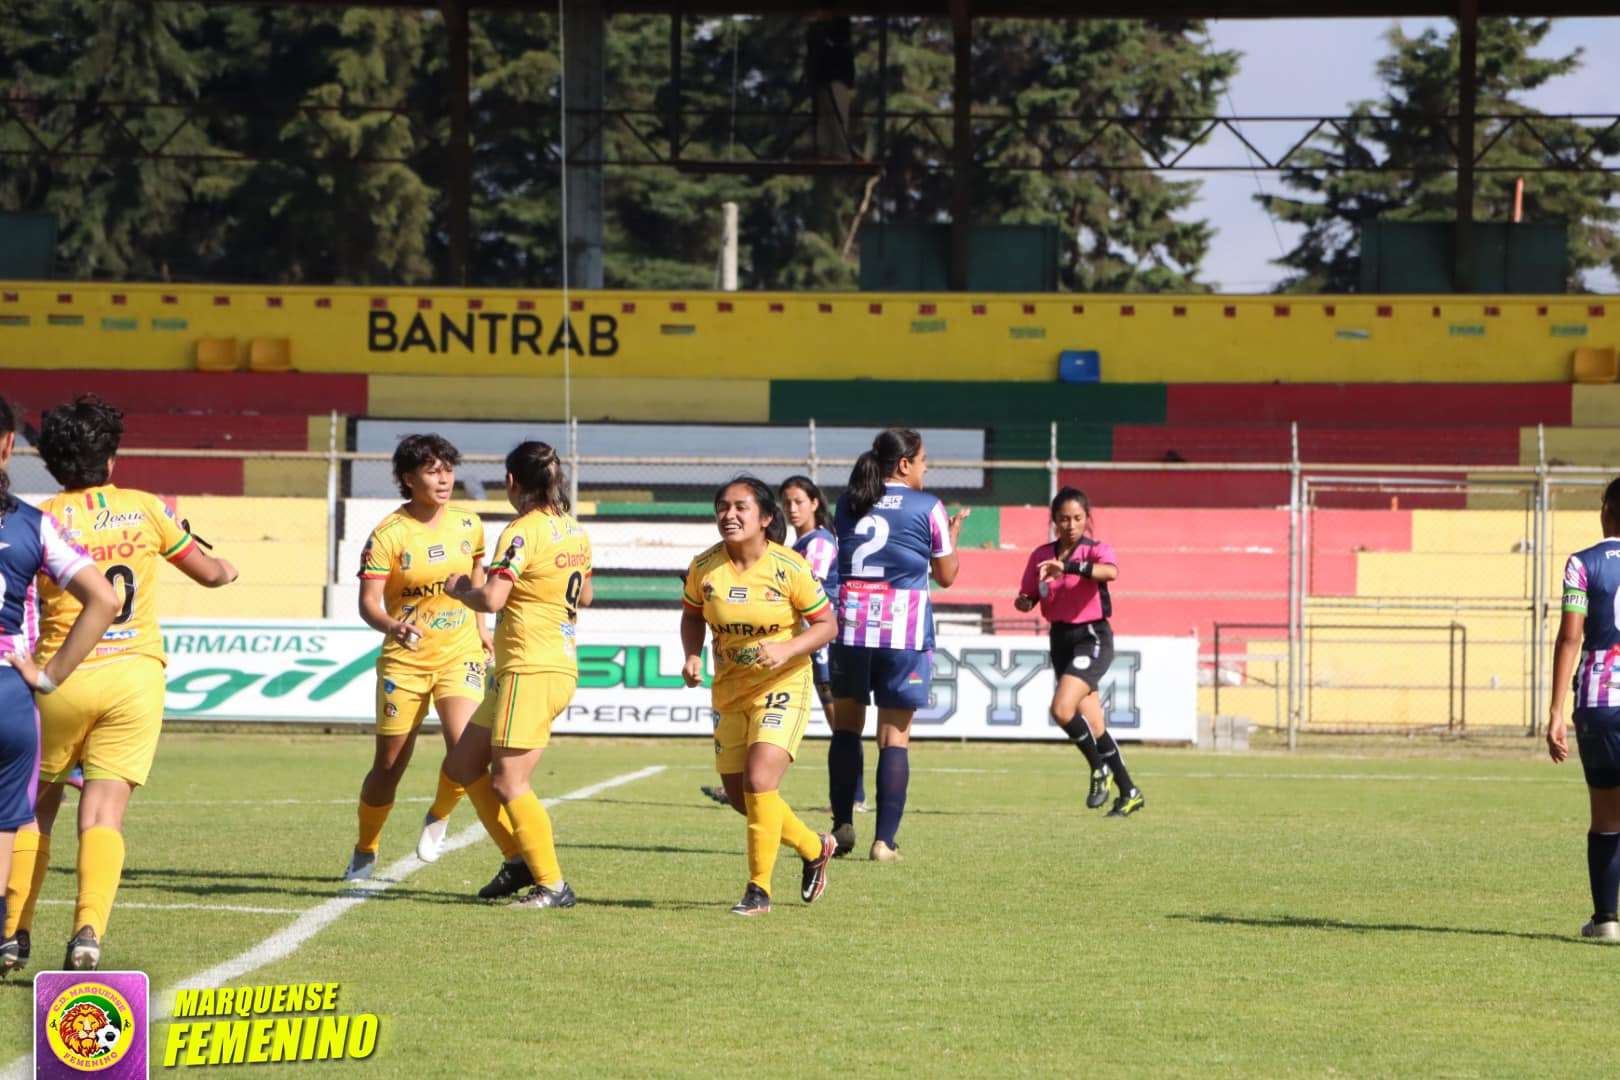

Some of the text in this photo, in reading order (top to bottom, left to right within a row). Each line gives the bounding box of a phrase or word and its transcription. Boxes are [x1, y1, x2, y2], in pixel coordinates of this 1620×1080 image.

[367, 309, 620, 357] BANTRAB
[83, 543, 135, 561] laro
[851, 514, 890, 577] 2
[555, 551, 587, 569] Claro
[401, 581, 445, 597] BANT
[711, 623, 780, 637] ANTRAB
[162, 635, 328, 653] RMACIAS
[764, 692, 790, 710] 12
[567, 704, 715, 723] PERFOR
